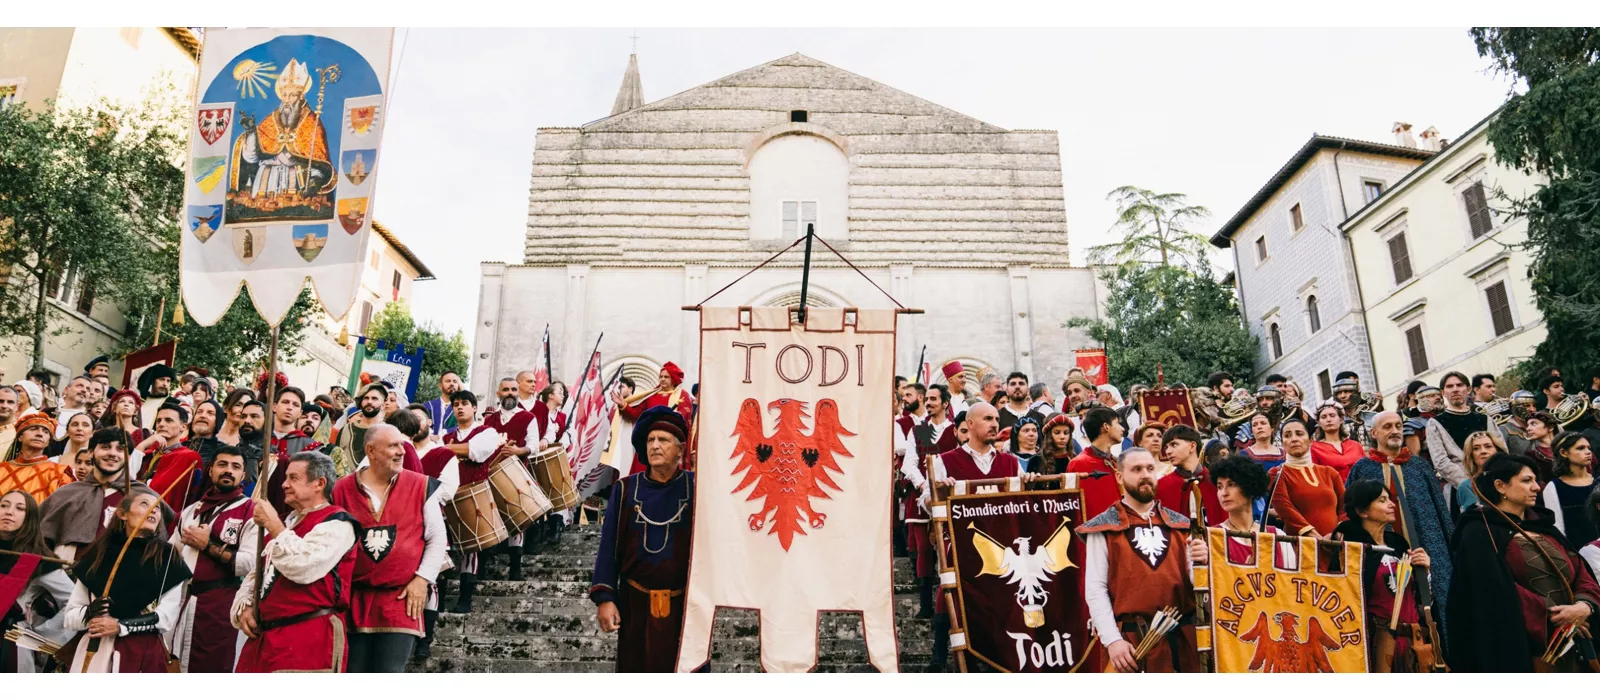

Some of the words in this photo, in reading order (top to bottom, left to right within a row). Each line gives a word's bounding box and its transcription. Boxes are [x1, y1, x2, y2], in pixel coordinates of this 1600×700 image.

[732, 341, 864, 386] TODI
[952, 501, 1030, 519] Sbandieratori
[1034, 503, 1040, 512] e
[1043, 499, 1080, 513] Musici
[1216, 573, 1274, 636] ARCVS
[1292, 578, 1362, 647] TVDER
[1006, 630, 1074, 671] Todi
